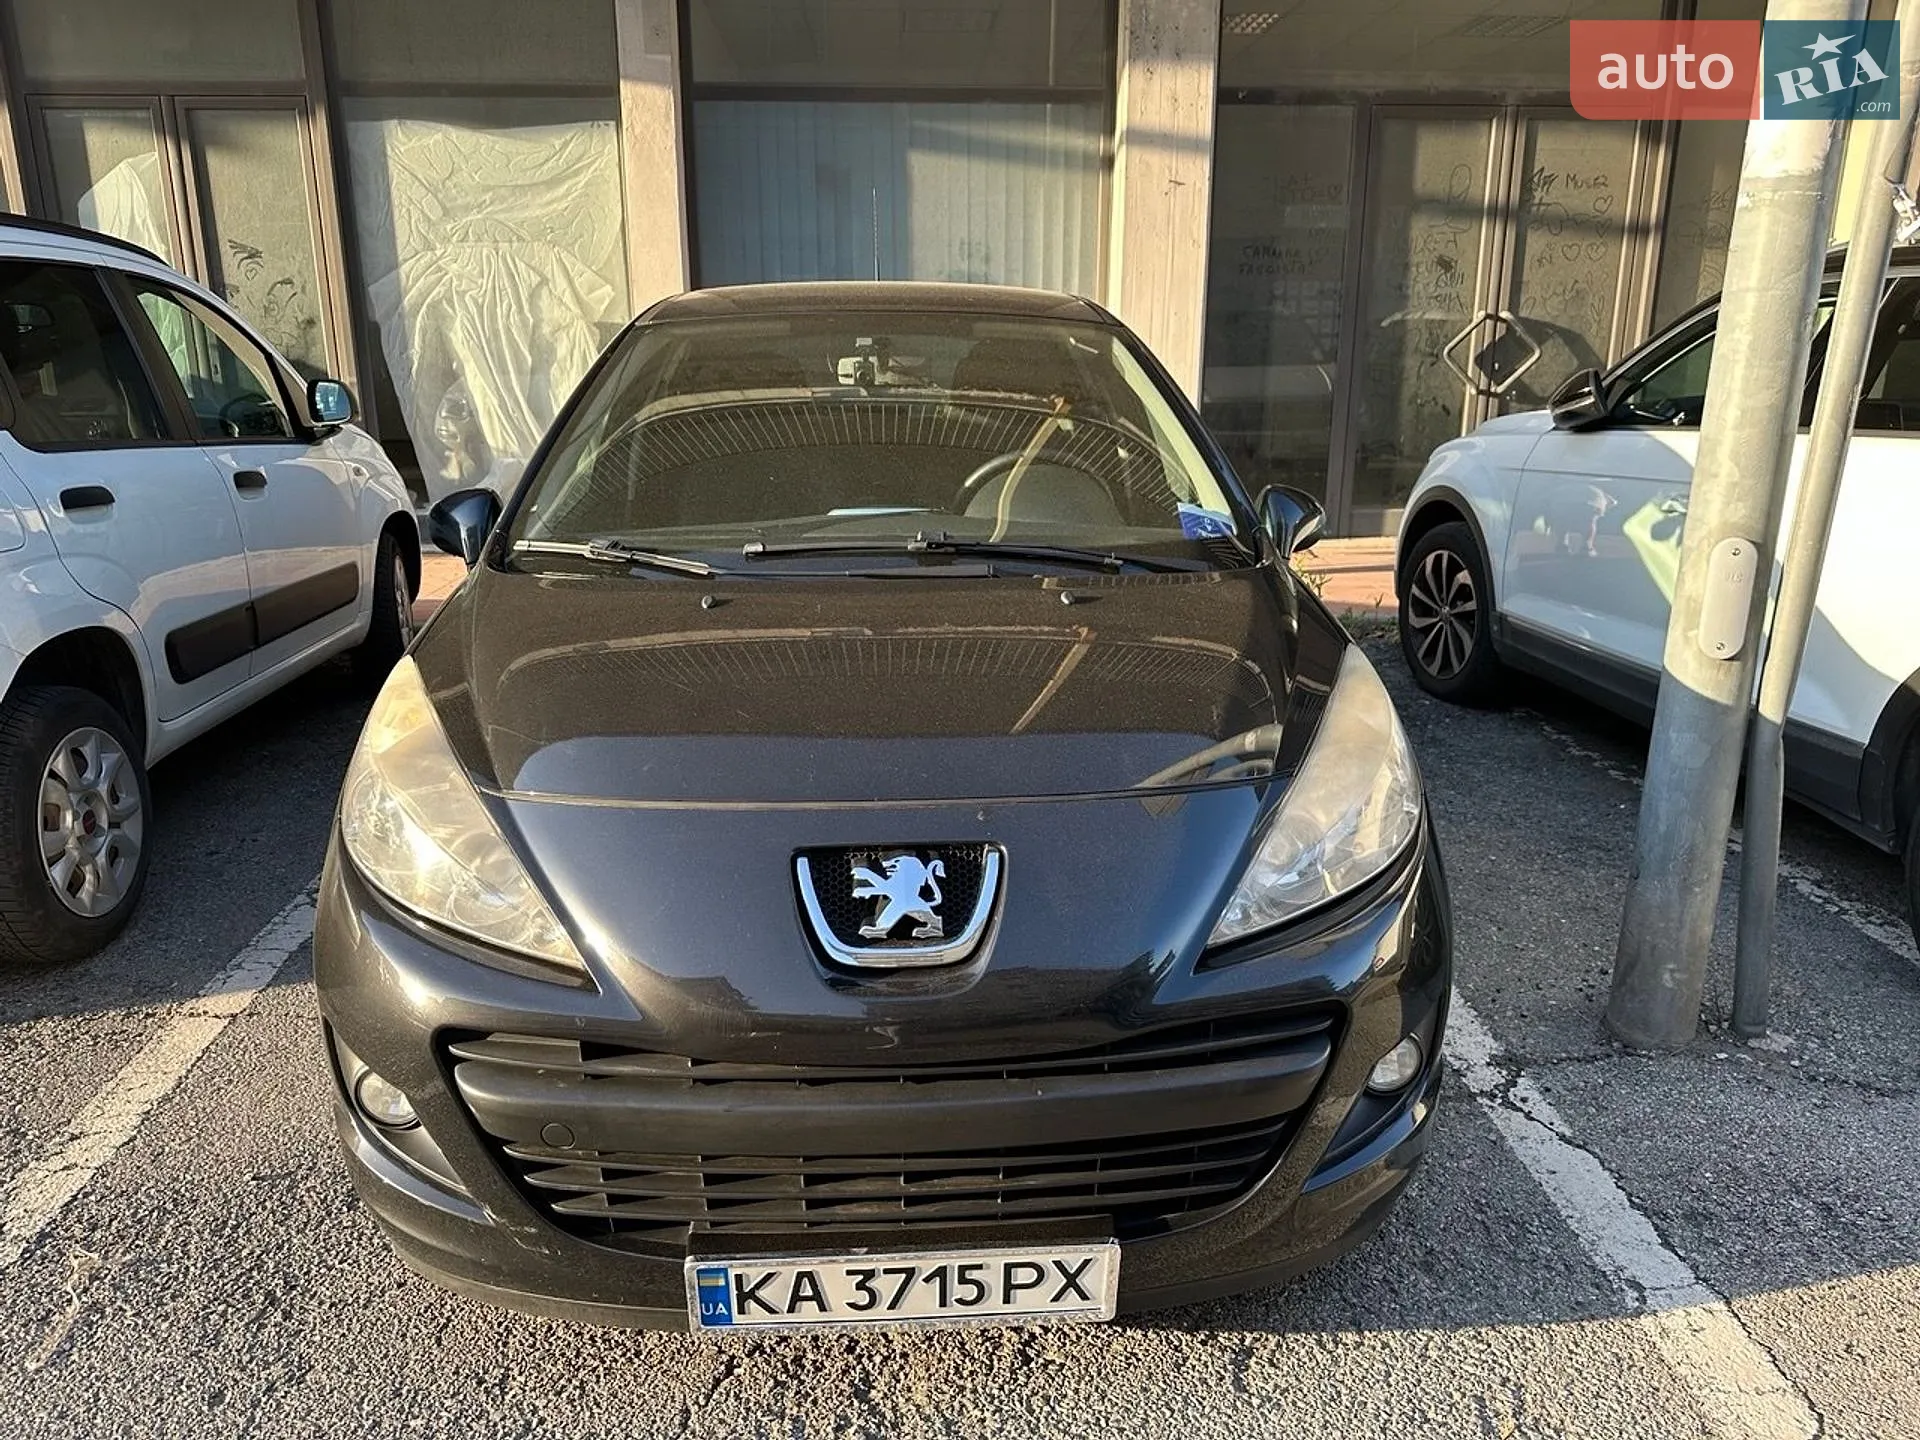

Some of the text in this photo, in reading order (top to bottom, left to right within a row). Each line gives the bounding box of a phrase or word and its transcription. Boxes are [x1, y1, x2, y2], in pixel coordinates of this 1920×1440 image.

[734, 1258, 1094, 1315] KA 3715 PX
[701, 1306, 728, 1316] UA
